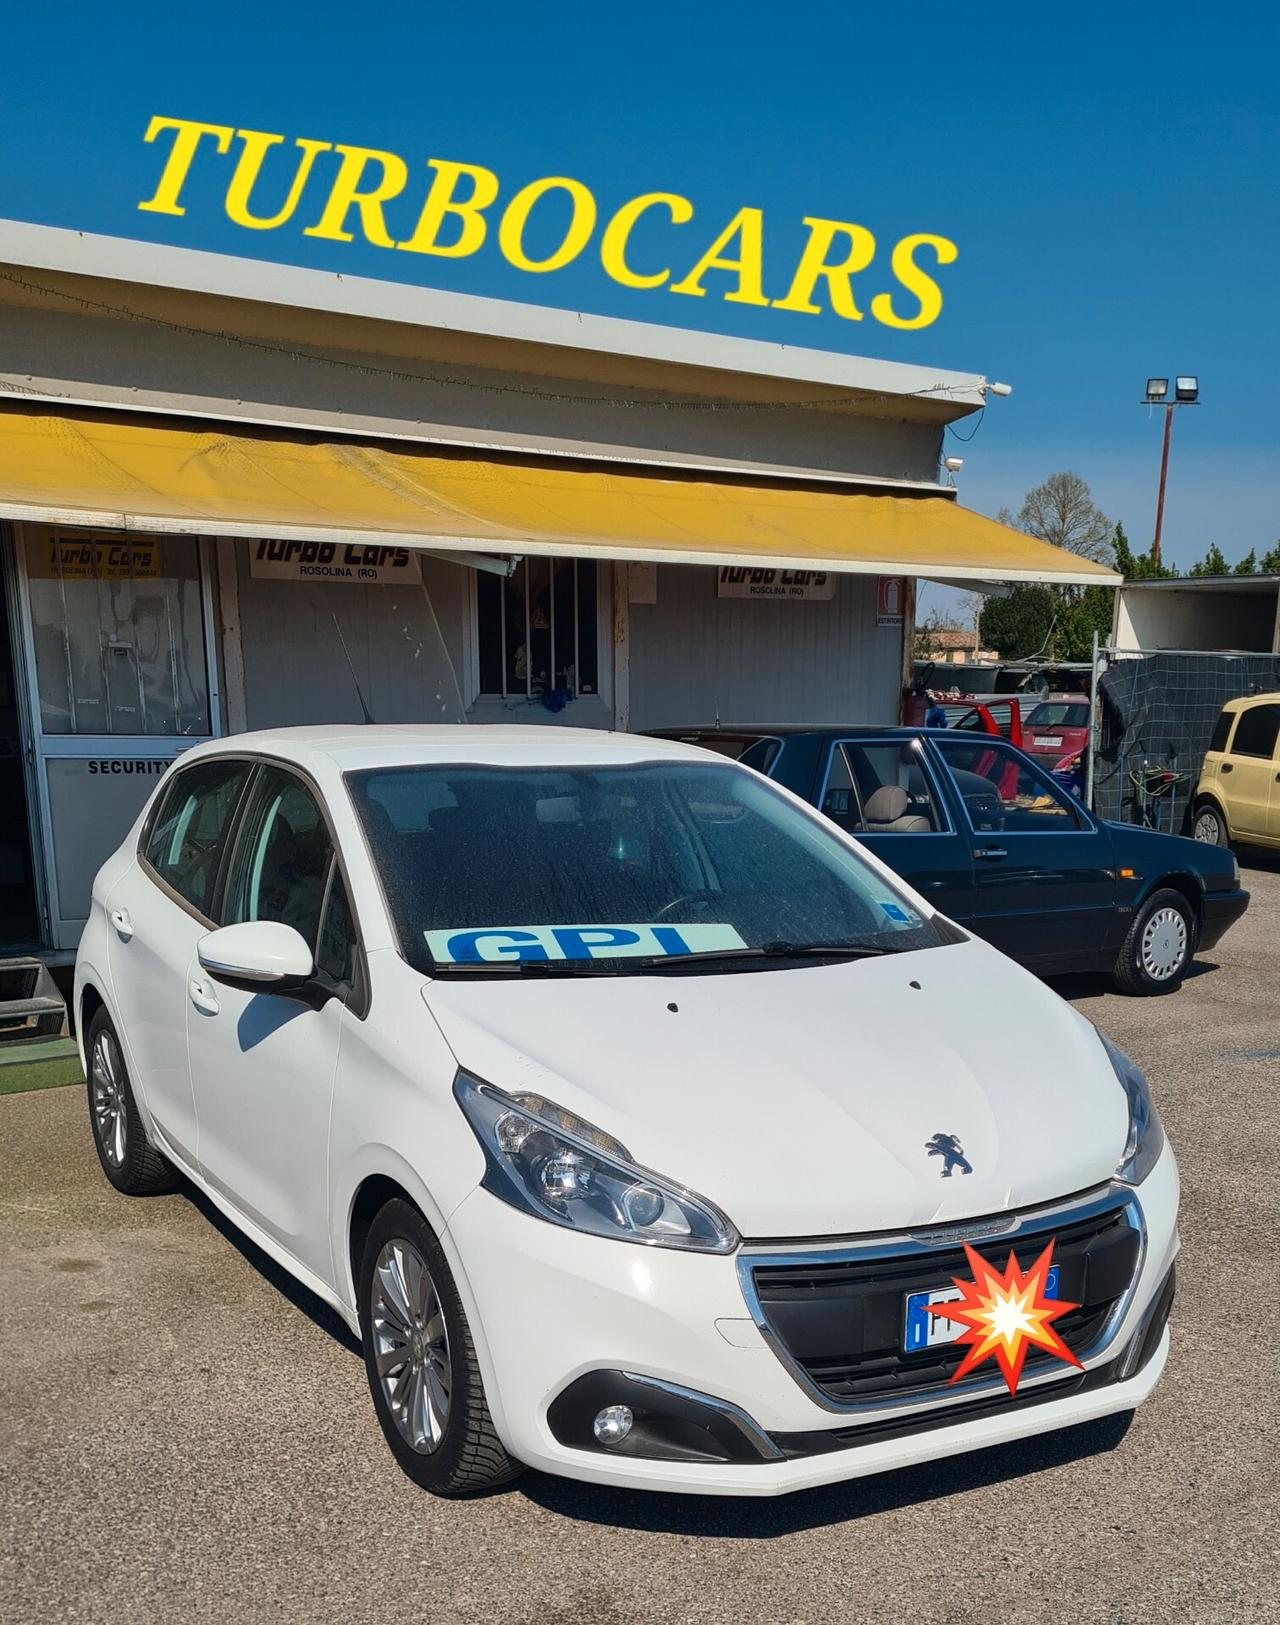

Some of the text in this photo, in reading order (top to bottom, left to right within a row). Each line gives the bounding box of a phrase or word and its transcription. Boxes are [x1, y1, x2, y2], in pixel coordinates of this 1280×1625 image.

[300, 565, 378, 580] ROSOLINA (RO)
[750, 586, 804, 597] ROSOLINA (RO)
